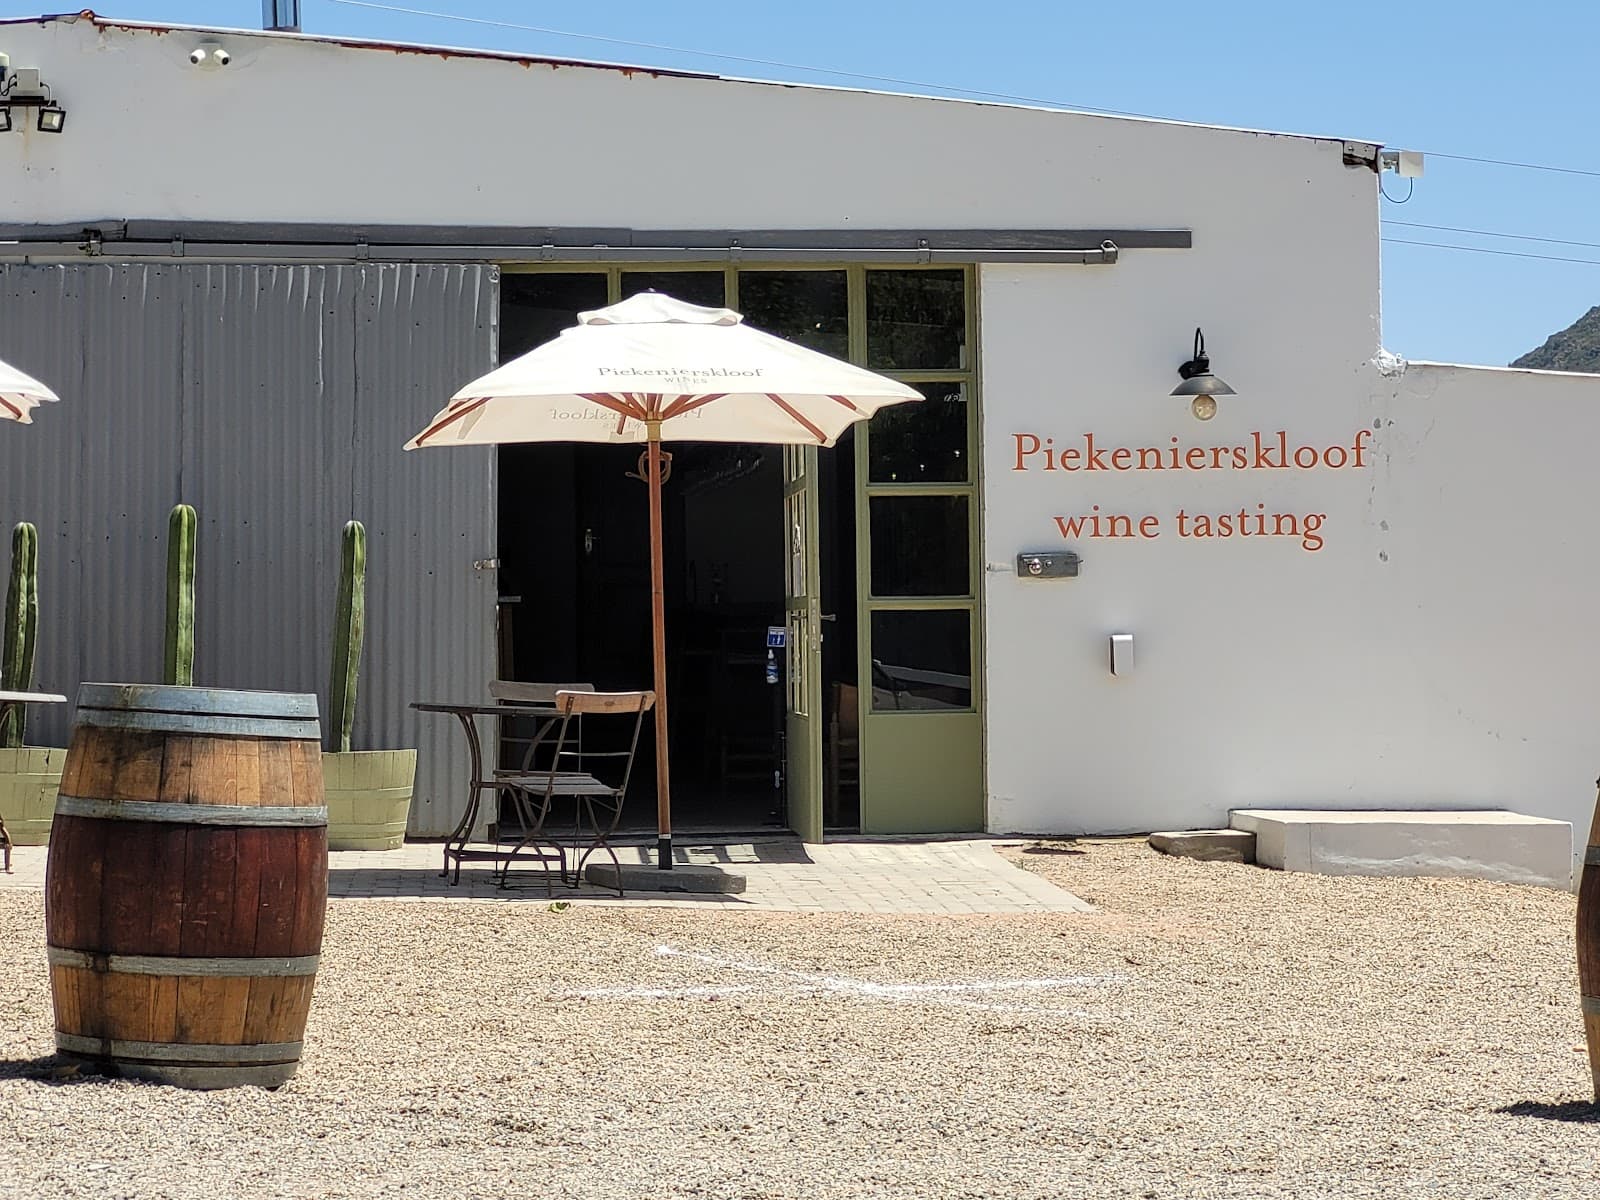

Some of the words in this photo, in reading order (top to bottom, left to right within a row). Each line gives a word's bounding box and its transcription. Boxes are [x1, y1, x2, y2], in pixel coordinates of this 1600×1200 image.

[598, 367, 764, 377] Piekenierskloof
[1011, 430, 1371, 471] Piekenierskloof
[1054, 504, 1160, 538] wine
[1176, 503, 1327, 551] tasting
